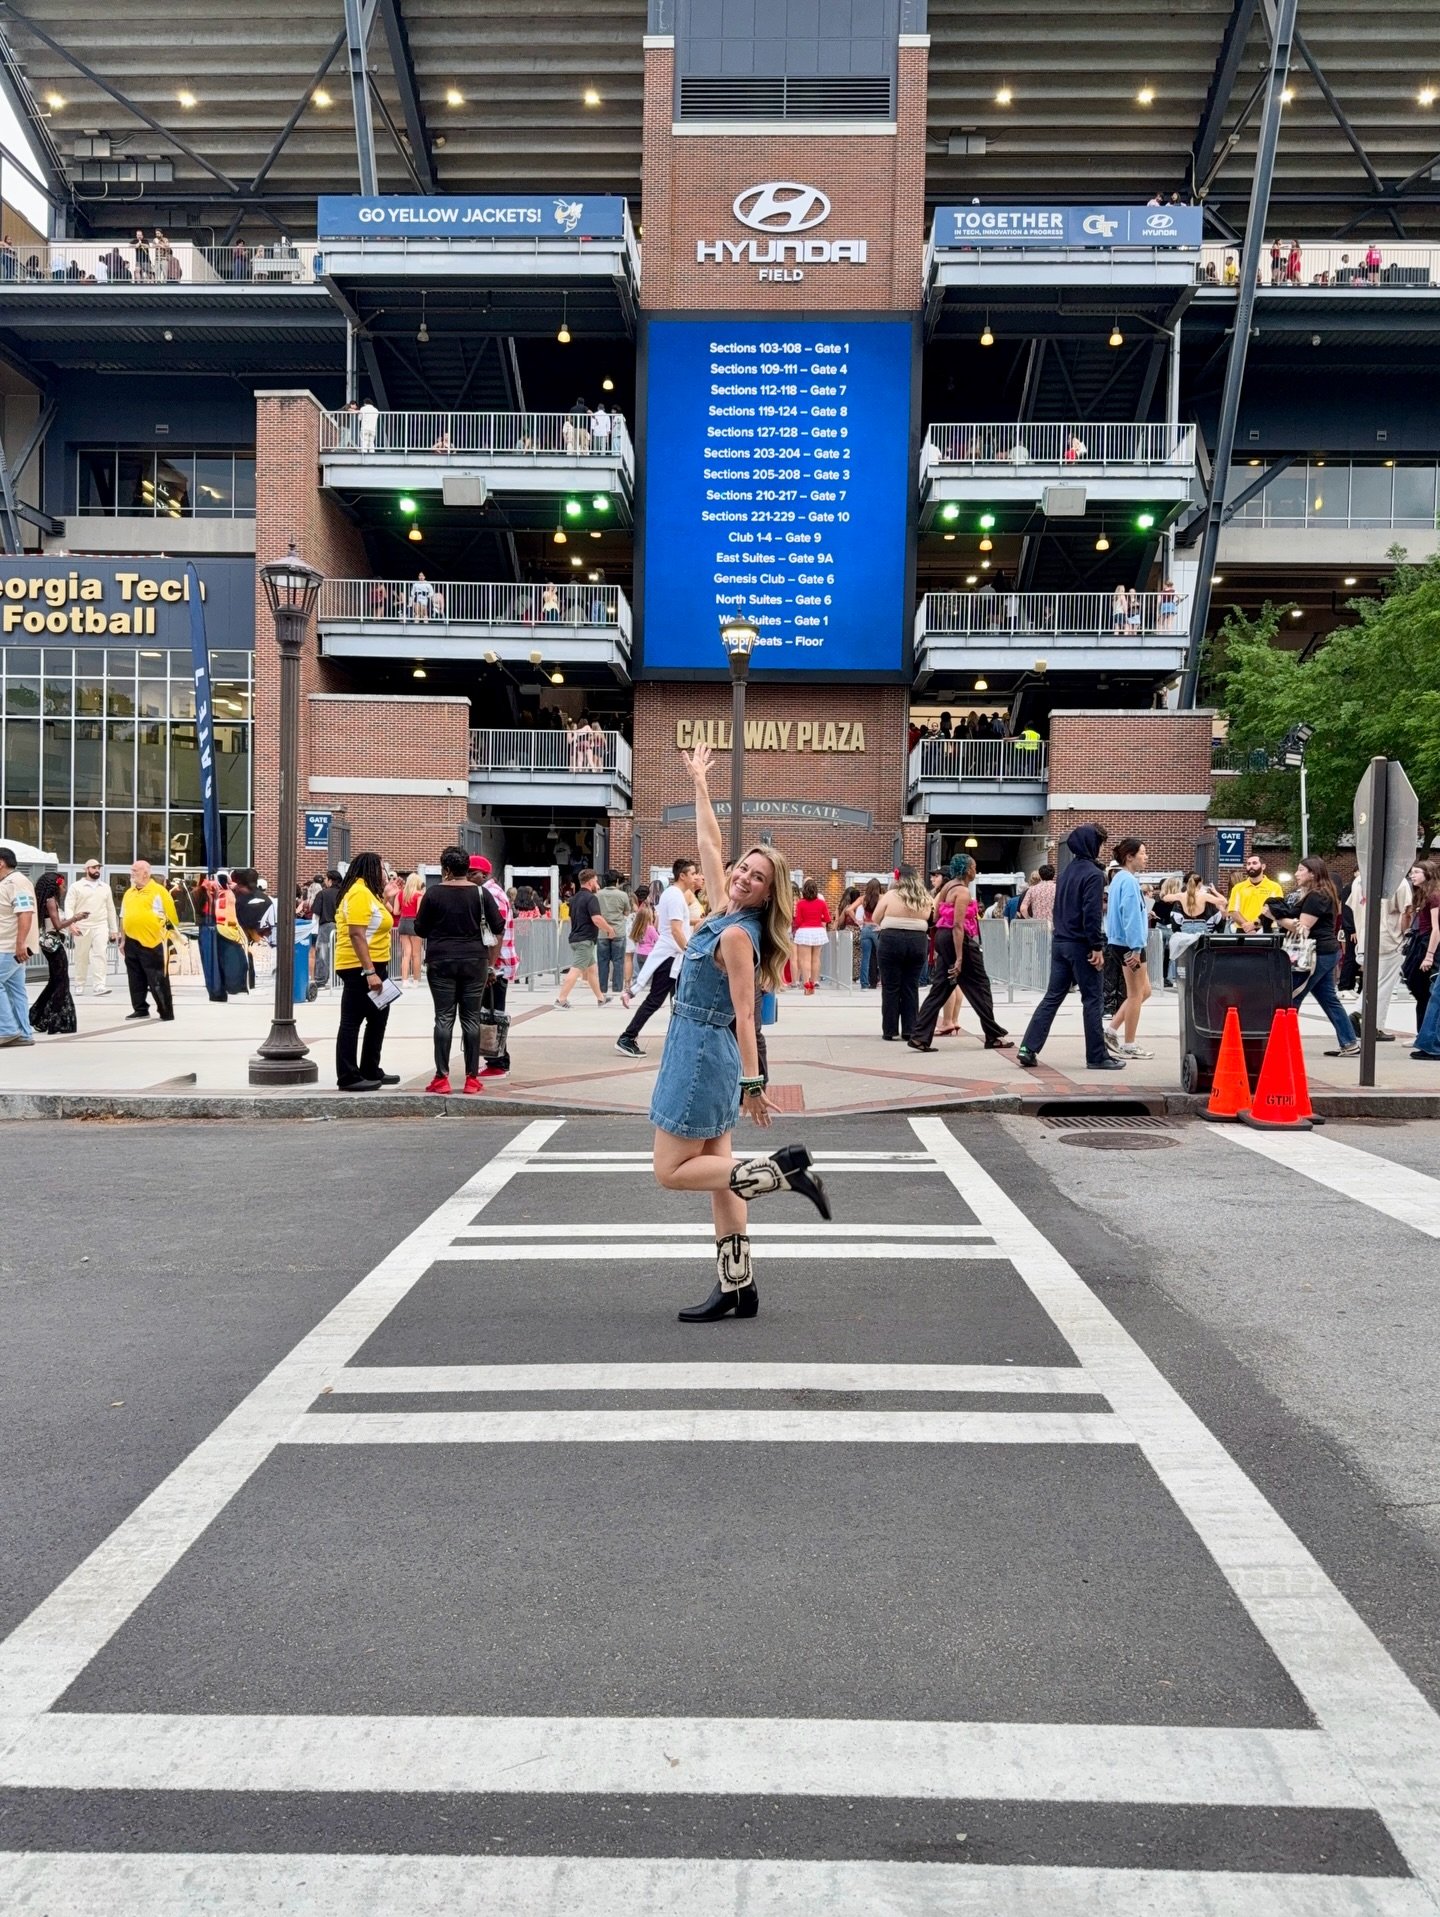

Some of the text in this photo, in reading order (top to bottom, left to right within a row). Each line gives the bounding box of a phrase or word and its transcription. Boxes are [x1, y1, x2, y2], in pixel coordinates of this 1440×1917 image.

[358, 208, 542, 223] GO YELLOW JACKETS!
[953, 212, 1064, 228] TOGETHER
[1142, 229, 1178, 237] HYUNDAI
[696, 239, 867, 263] HYUNDAI
[758, 268, 804, 281] FIELD
[709, 342, 757, 354] Sections
[759, 342, 802, 354] 103-108
[814, 342, 842, 354] Gate
[843, 343, 849, 354] 1
[710, 363, 758, 375] Sections
[760, 363, 798, 375] 109-111
[810, 363, 838, 375] Gate
[839, 364, 848, 375] 4
[710, 384, 758, 396] Sections
[760, 384, 798, 396] 112-118
[810, 384, 837, 396] Gate
[839, 385, 847, 396] 7
[708, 405, 756, 417] Sections
[758, 405, 798, 417] 119-124
[810, 405, 837, 417] Gate
[839, 406, 848, 417] 8
[707, 426, 754, 438] Sections
[756, 426, 798, 438] 127-128
[810, 427, 838, 438] Gate
[840, 427, 849, 438] 9
[703, 447, 751, 459] Sections
[753, 447, 801, 459] 203-204
[813, 448, 840, 459] Gate
[842, 448, 851, 459] 2
[703, 468, 751, 480] Sections
[752, 468, 801, 480] 205-208
[813, 469, 840, 480] Gate
[842, 469, 850, 481] 3
[706, 489, 753, 501] Sections
[755, 490, 798, 501] 210-217
[810, 490, 837, 501] Gate
[839, 490, 847, 501] 7
[701, 510, 749, 522] Sections
[750, 511, 796, 522] 221-229
[808, 511, 835, 522] Gate
[837, 511, 850, 522] 10
[728, 531, 754, 543] Club
[756, 532, 773, 543] 1-4
[785, 532, 812, 543] Gate
[813, 532, 822, 543] 9
[716, 552, 740, 563] East
[742, 552, 776, 564] Suites
[788, 552, 815, 564] Gate
[817, 552, 834, 564] 9A
[713, 572, 758, 584] Genesis
[759, 573, 786, 584] Club
[797, 573, 825, 585] Gate
[826, 574, 835, 585] 6
[0, 571, 104, 607] orgia
[715, 593, 747, 605] North
[749, 594, 783, 605] Suites
[795, 594, 822, 606] Gate
[823, 594, 832, 606] 6
[3, 604, 156, 635] Football
[747, 614, 782, 626] Suites
[794, 615, 821, 626] Gate
[823, 615, 829, 626] 1
[754, 635, 783, 647] Seats
[795, 635, 824, 647] Floor
[676, 719, 866, 751] CALLWAY PLAZA
[752, 801, 799, 814] JONES
[801, 804, 841, 819] GATE
[308, 816, 328, 824] GATE
[313, 823, 325, 837] 7
[1220, 832, 1242, 840] GATE
[1225, 840, 1237, 854] 7
